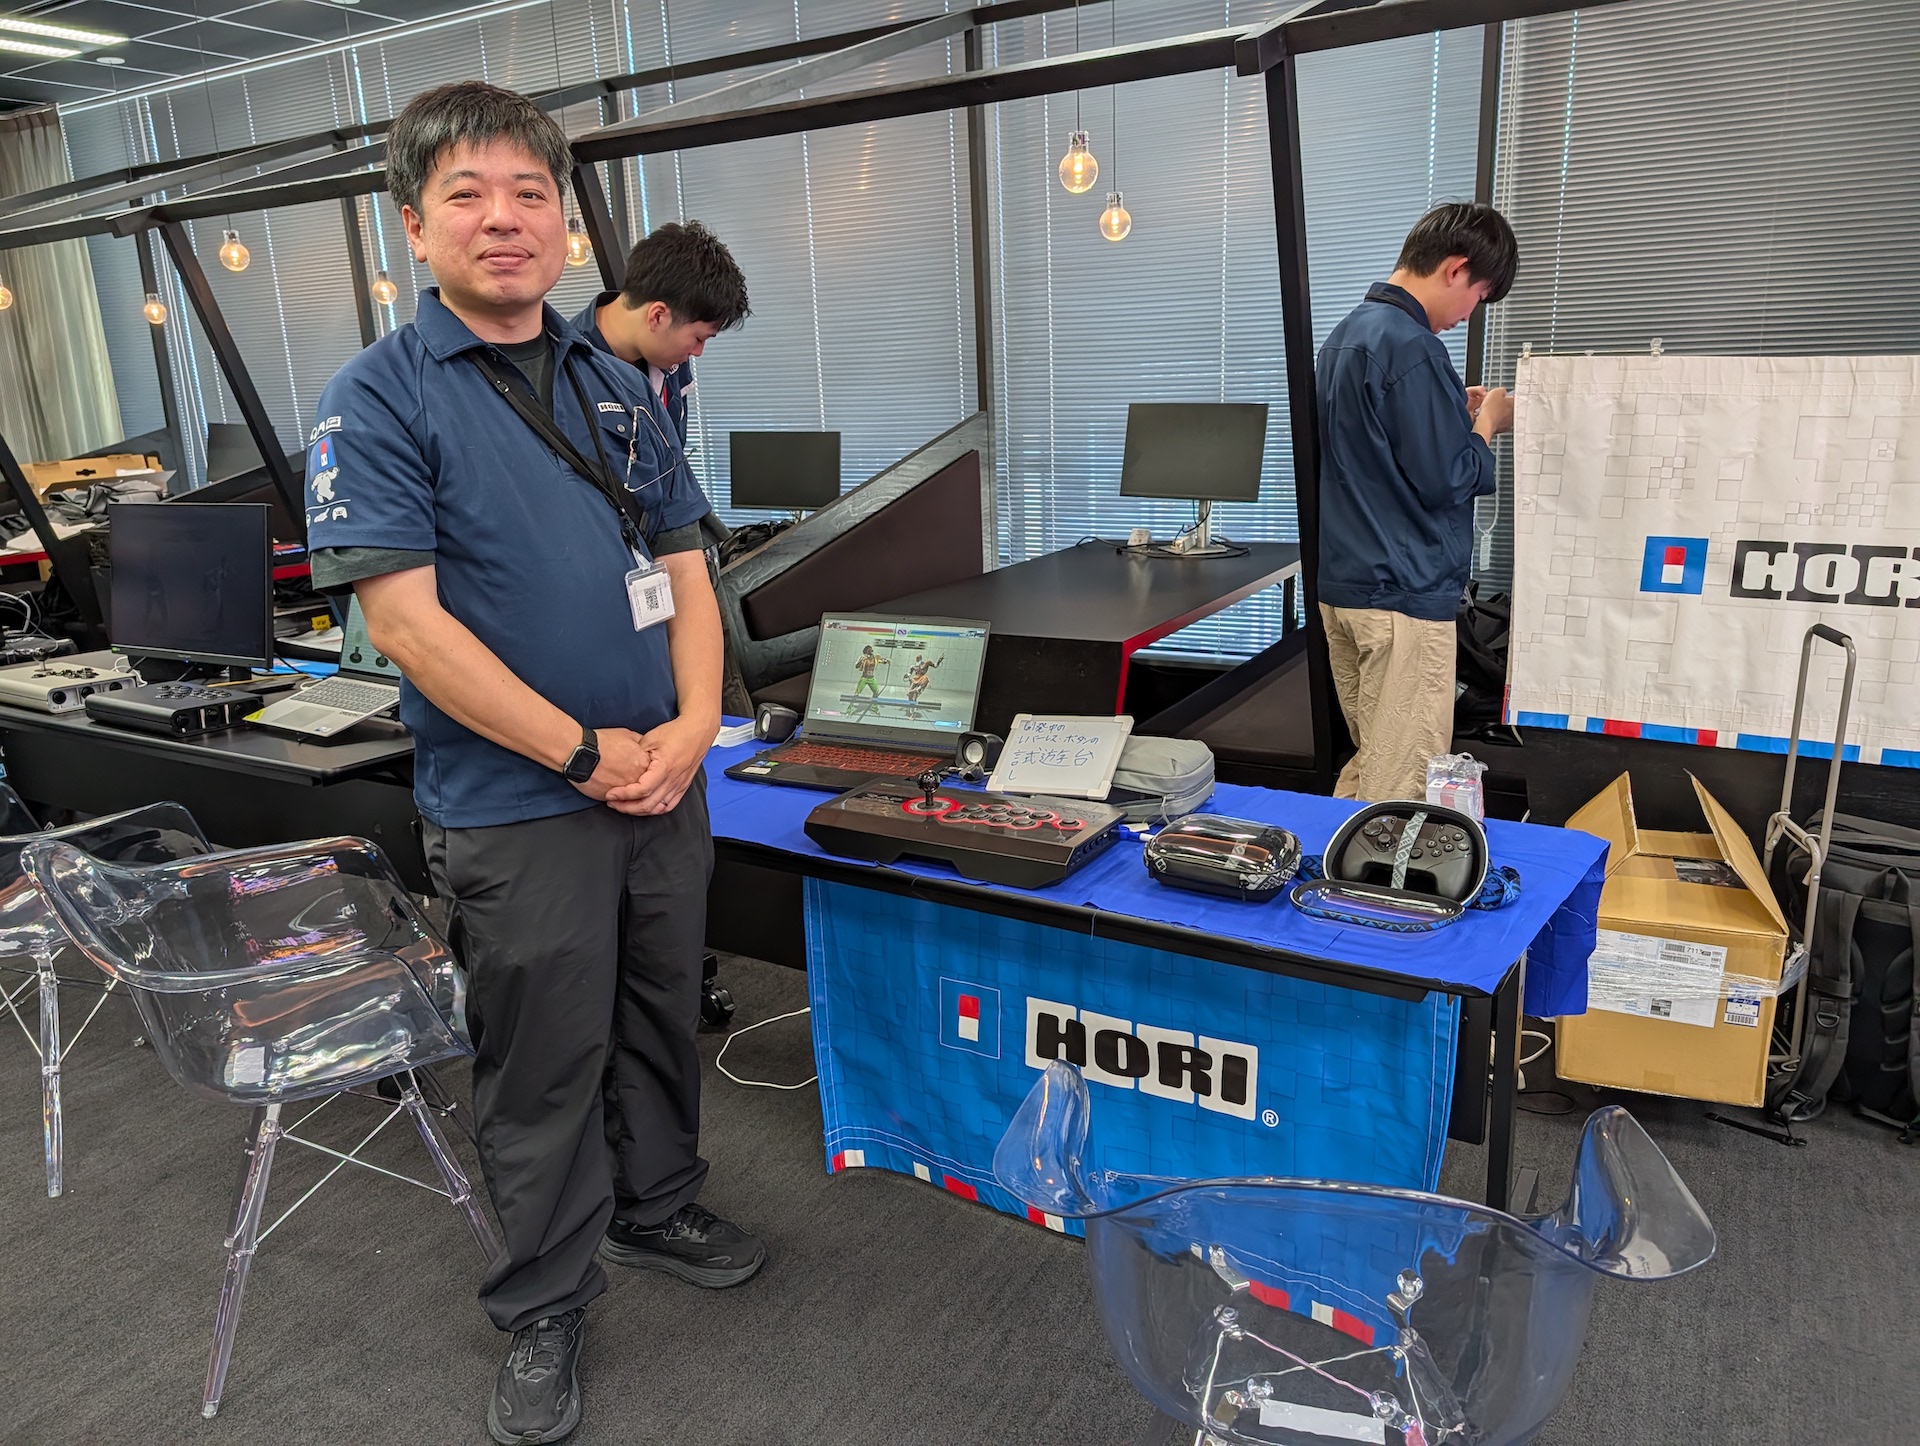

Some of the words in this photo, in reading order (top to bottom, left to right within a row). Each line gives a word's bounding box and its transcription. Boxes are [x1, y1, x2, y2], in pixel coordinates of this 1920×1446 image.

[599, 403, 624, 411] HORI
[1740, 549, 1920, 601] HOR
[1010, 747, 1095, 767] 試遊台
[1034, 1010, 1250, 1107] HORI
